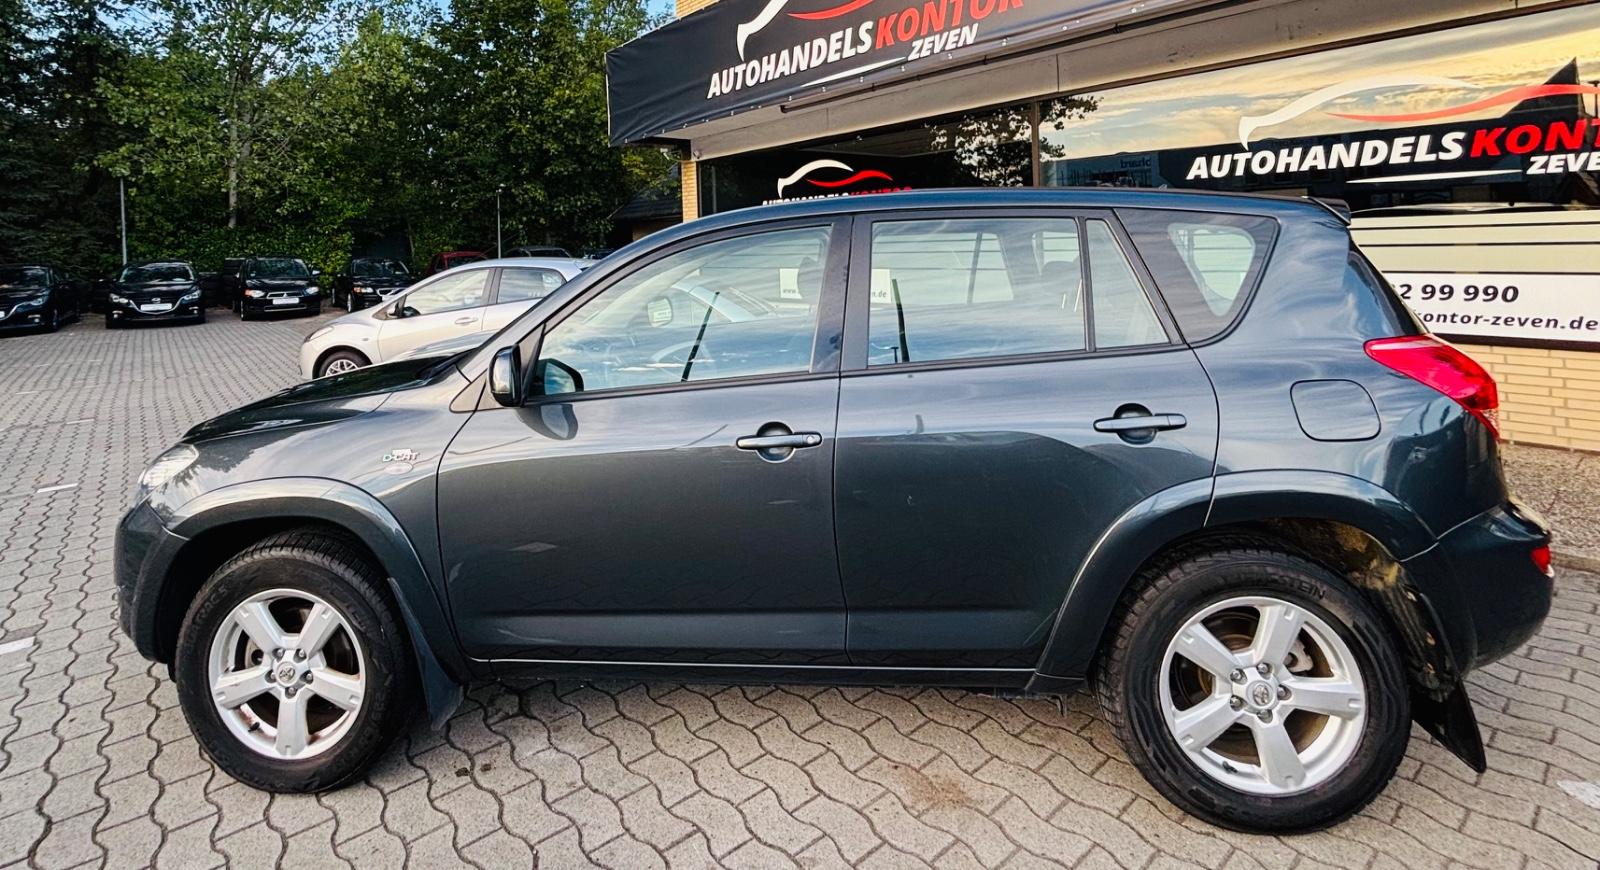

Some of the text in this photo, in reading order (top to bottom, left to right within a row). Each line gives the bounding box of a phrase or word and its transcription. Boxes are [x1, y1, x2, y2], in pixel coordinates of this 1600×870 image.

[907, 23, 979, 61] ZEVEN
[1395, 284, 1520, 303] 2 99 990
[1417, 311, 1599, 331] ontor-zeven.de
